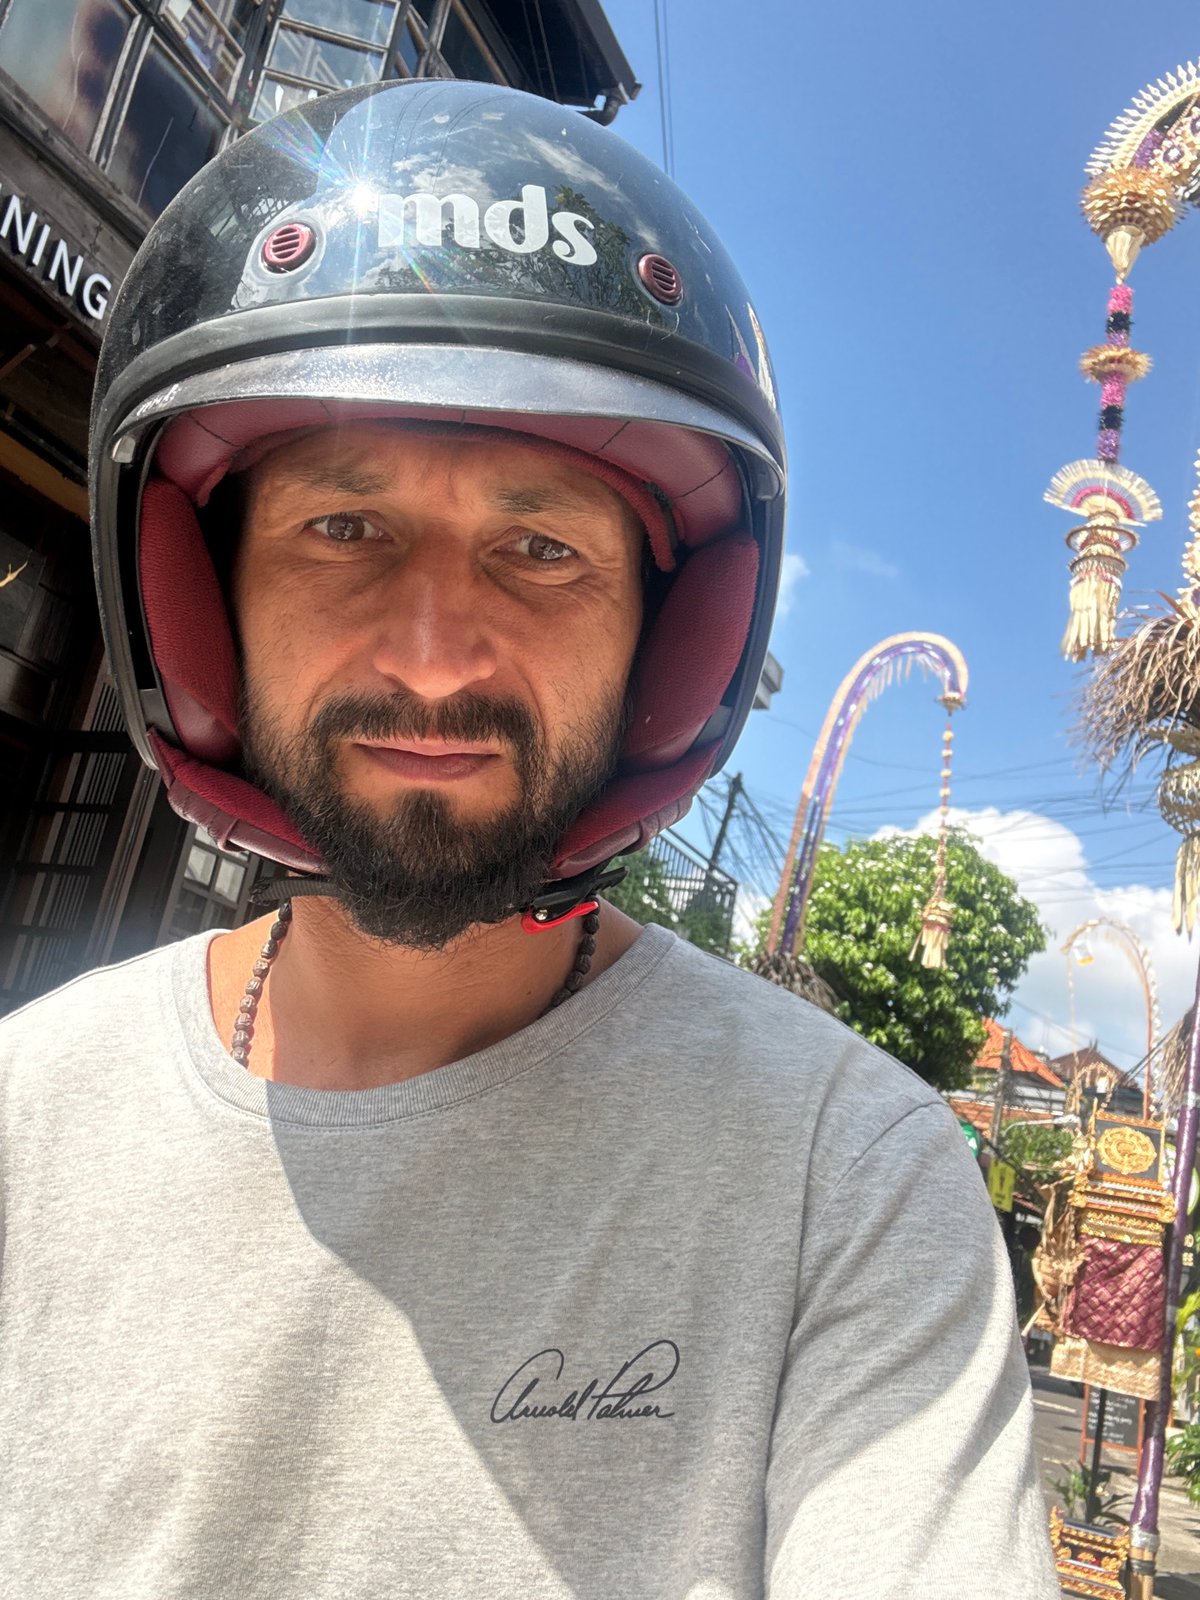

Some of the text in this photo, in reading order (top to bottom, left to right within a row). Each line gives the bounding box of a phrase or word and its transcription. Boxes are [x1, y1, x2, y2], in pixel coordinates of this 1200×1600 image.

[0, 183, 112, 320] NING
[378, 184, 598, 266] mds
[588, 1339, 681, 1421] Palmer
